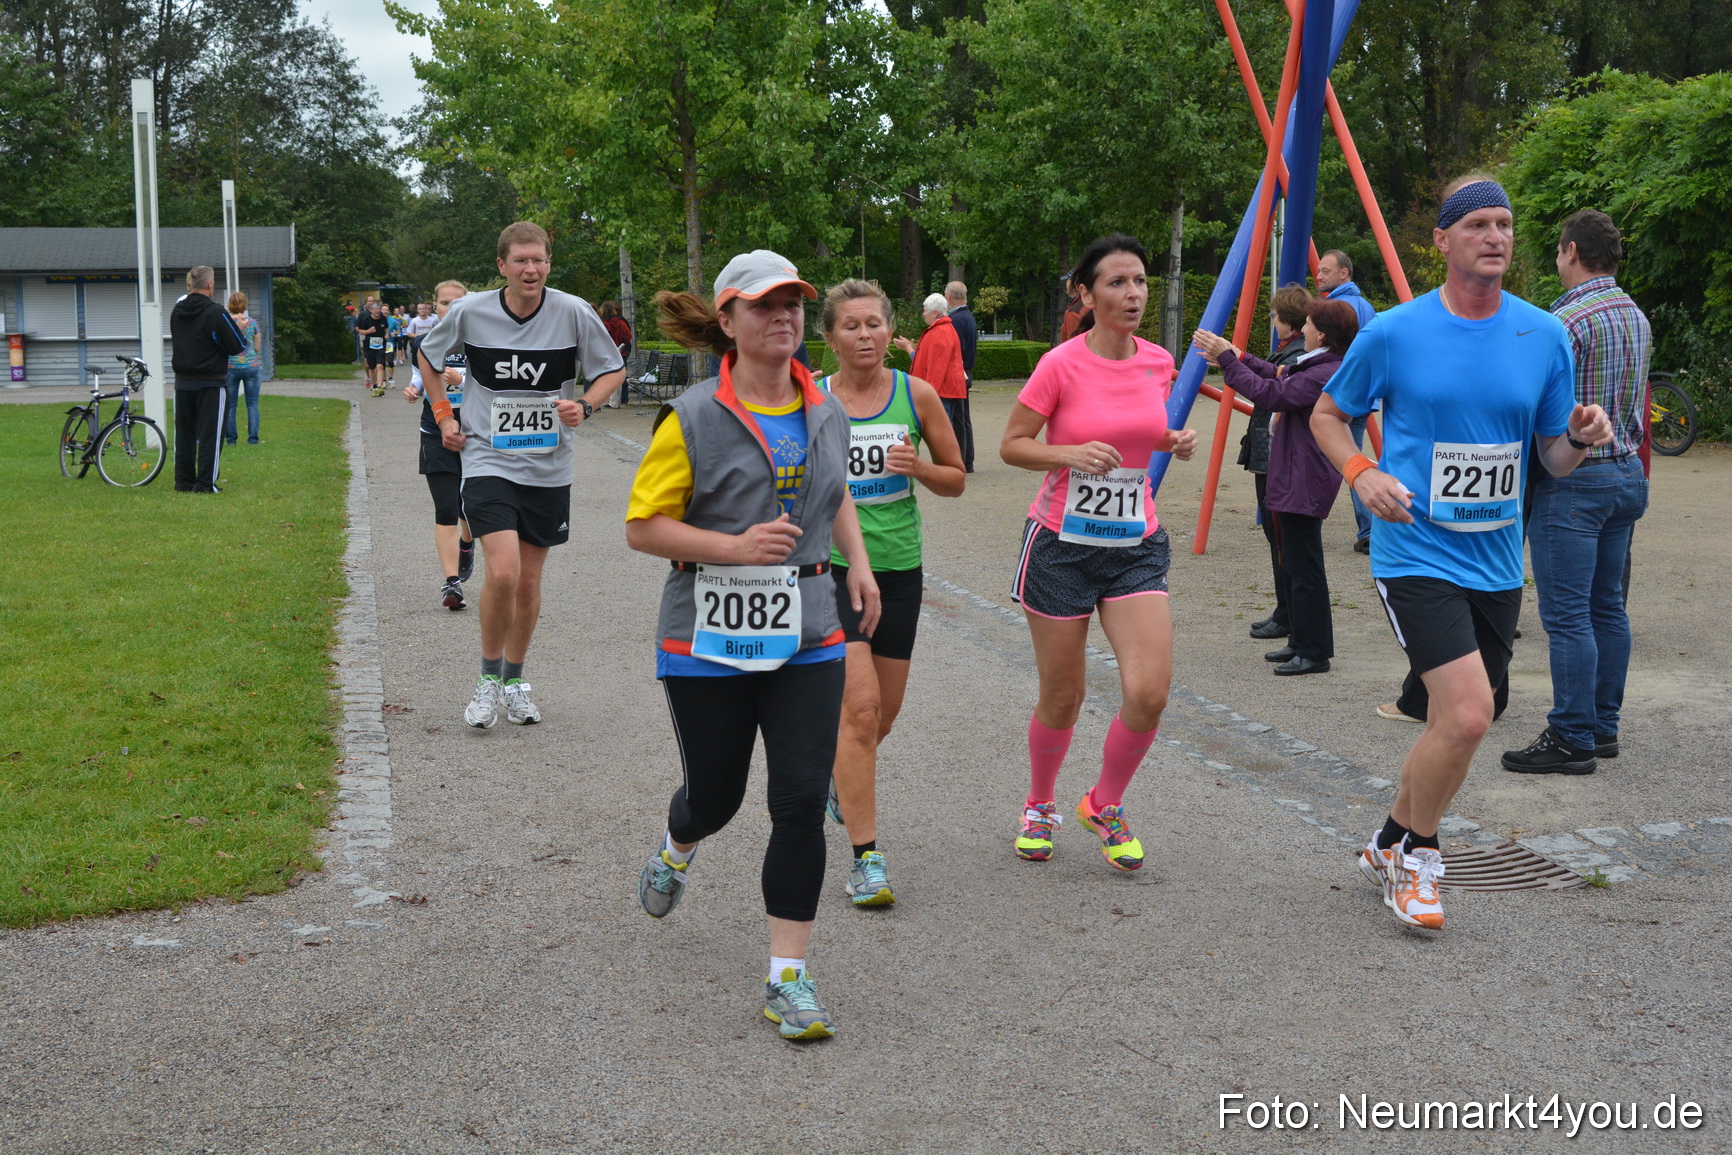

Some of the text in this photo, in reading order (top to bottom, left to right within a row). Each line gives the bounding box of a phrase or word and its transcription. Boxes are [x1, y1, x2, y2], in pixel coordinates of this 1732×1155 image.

[494, 354, 547, 386] sky
[498, 411, 553, 432] 2445
[506, 437, 544, 447] Joachim
[851, 433, 895, 442] Neumarkt
[848, 444, 895, 476] 89
[1435, 451, 1512, 461] PARTL Neumarkt
[1071, 470, 1136, 484] PARTL Neumarkt
[1441, 464, 1514, 498] 2210
[849, 482, 885, 496] Gisela
[1074, 484, 1137, 517] 2211
[1454, 505, 1501, 519] Manfred
[1084, 522, 1127, 537] Martina
[698, 573, 782, 587] PARTL Neumarkt
[704, 591, 791, 630] 2082
[725, 640, 764, 659] Birgit
